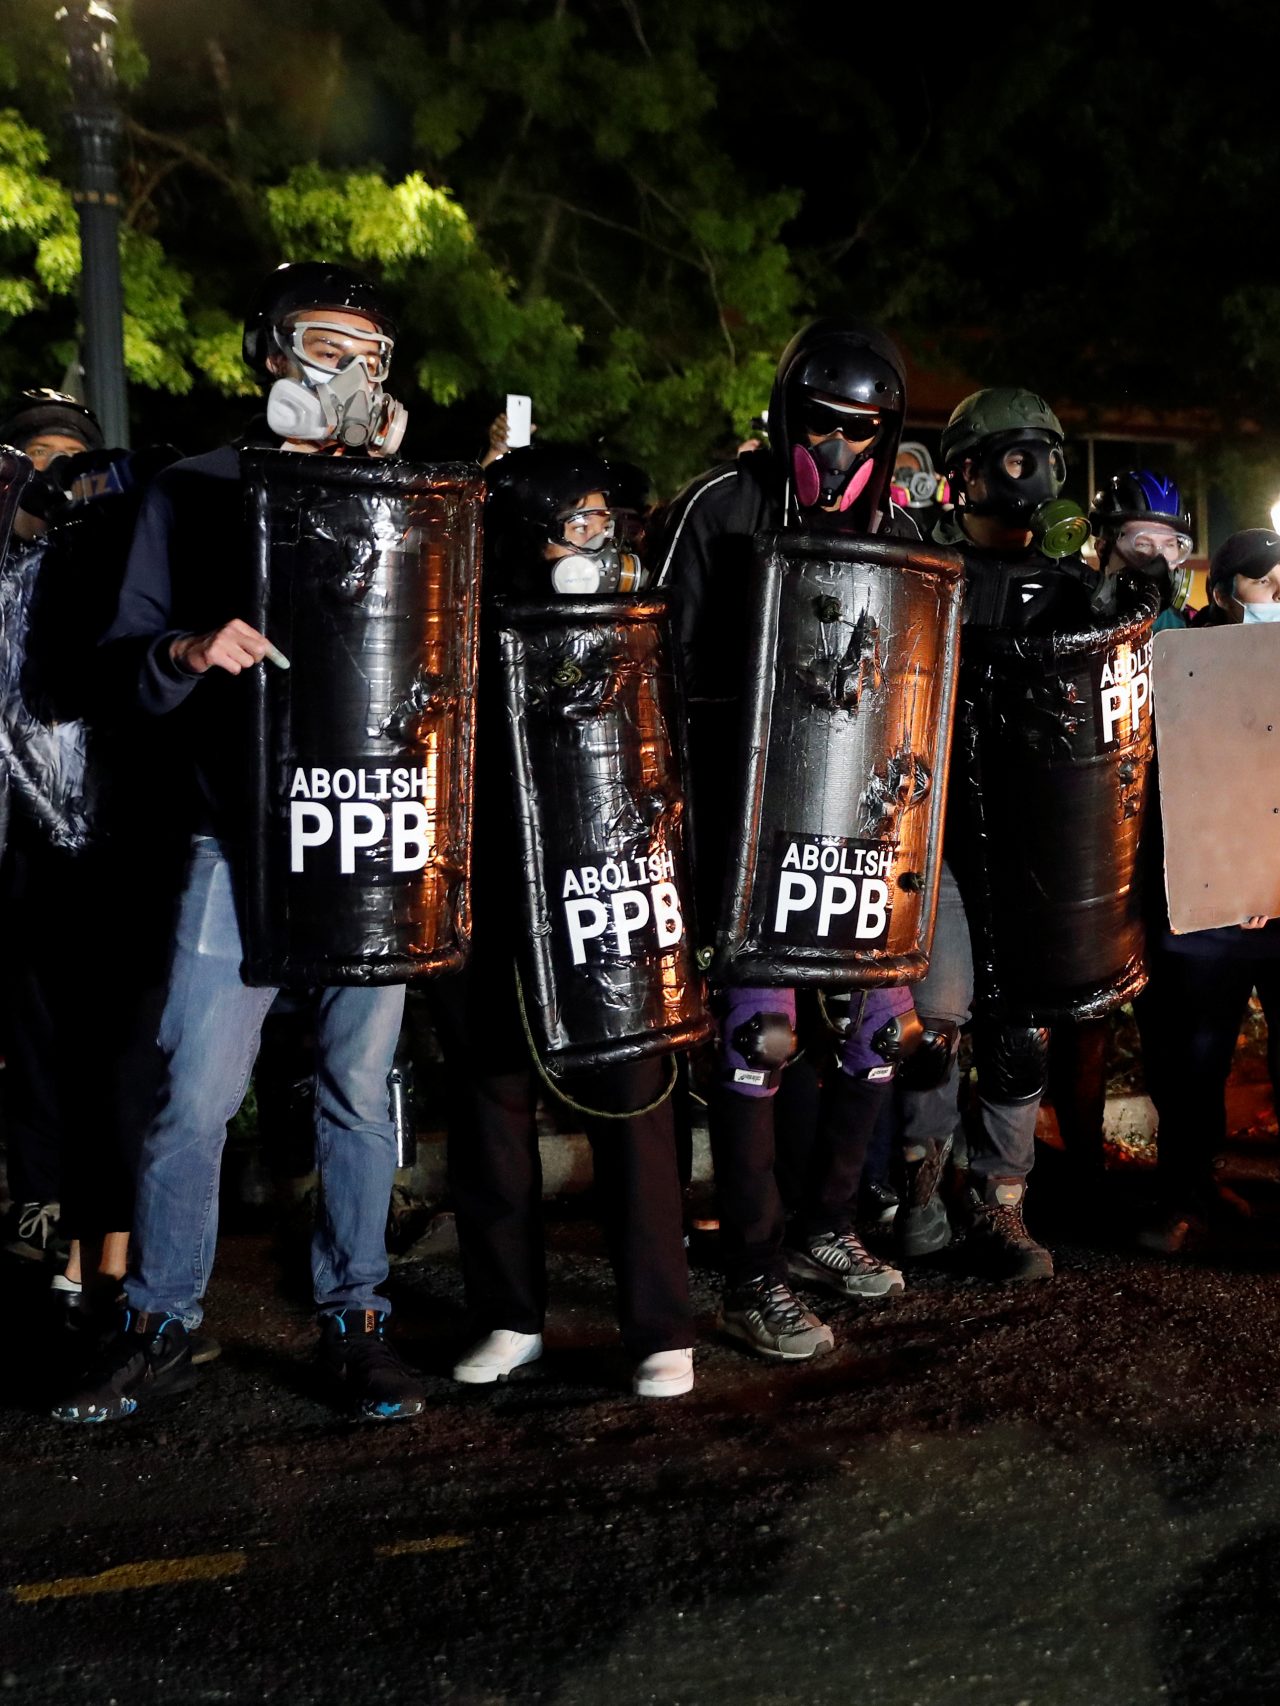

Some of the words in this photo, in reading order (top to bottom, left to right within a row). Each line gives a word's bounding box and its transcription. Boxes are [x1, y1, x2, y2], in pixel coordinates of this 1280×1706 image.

[1100, 637, 1153, 688] ABOLIS
[1101, 658, 1153, 744] PP
[290, 768, 430, 799] ABOLISH
[290, 800, 430, 874] PPB
[782, 843, 893, 877] ABOLISH
[562, 851, 675, 897] ABOLISH
[565, 882, 683, 965] PPB
[775, 871, 888, 940] PPB
